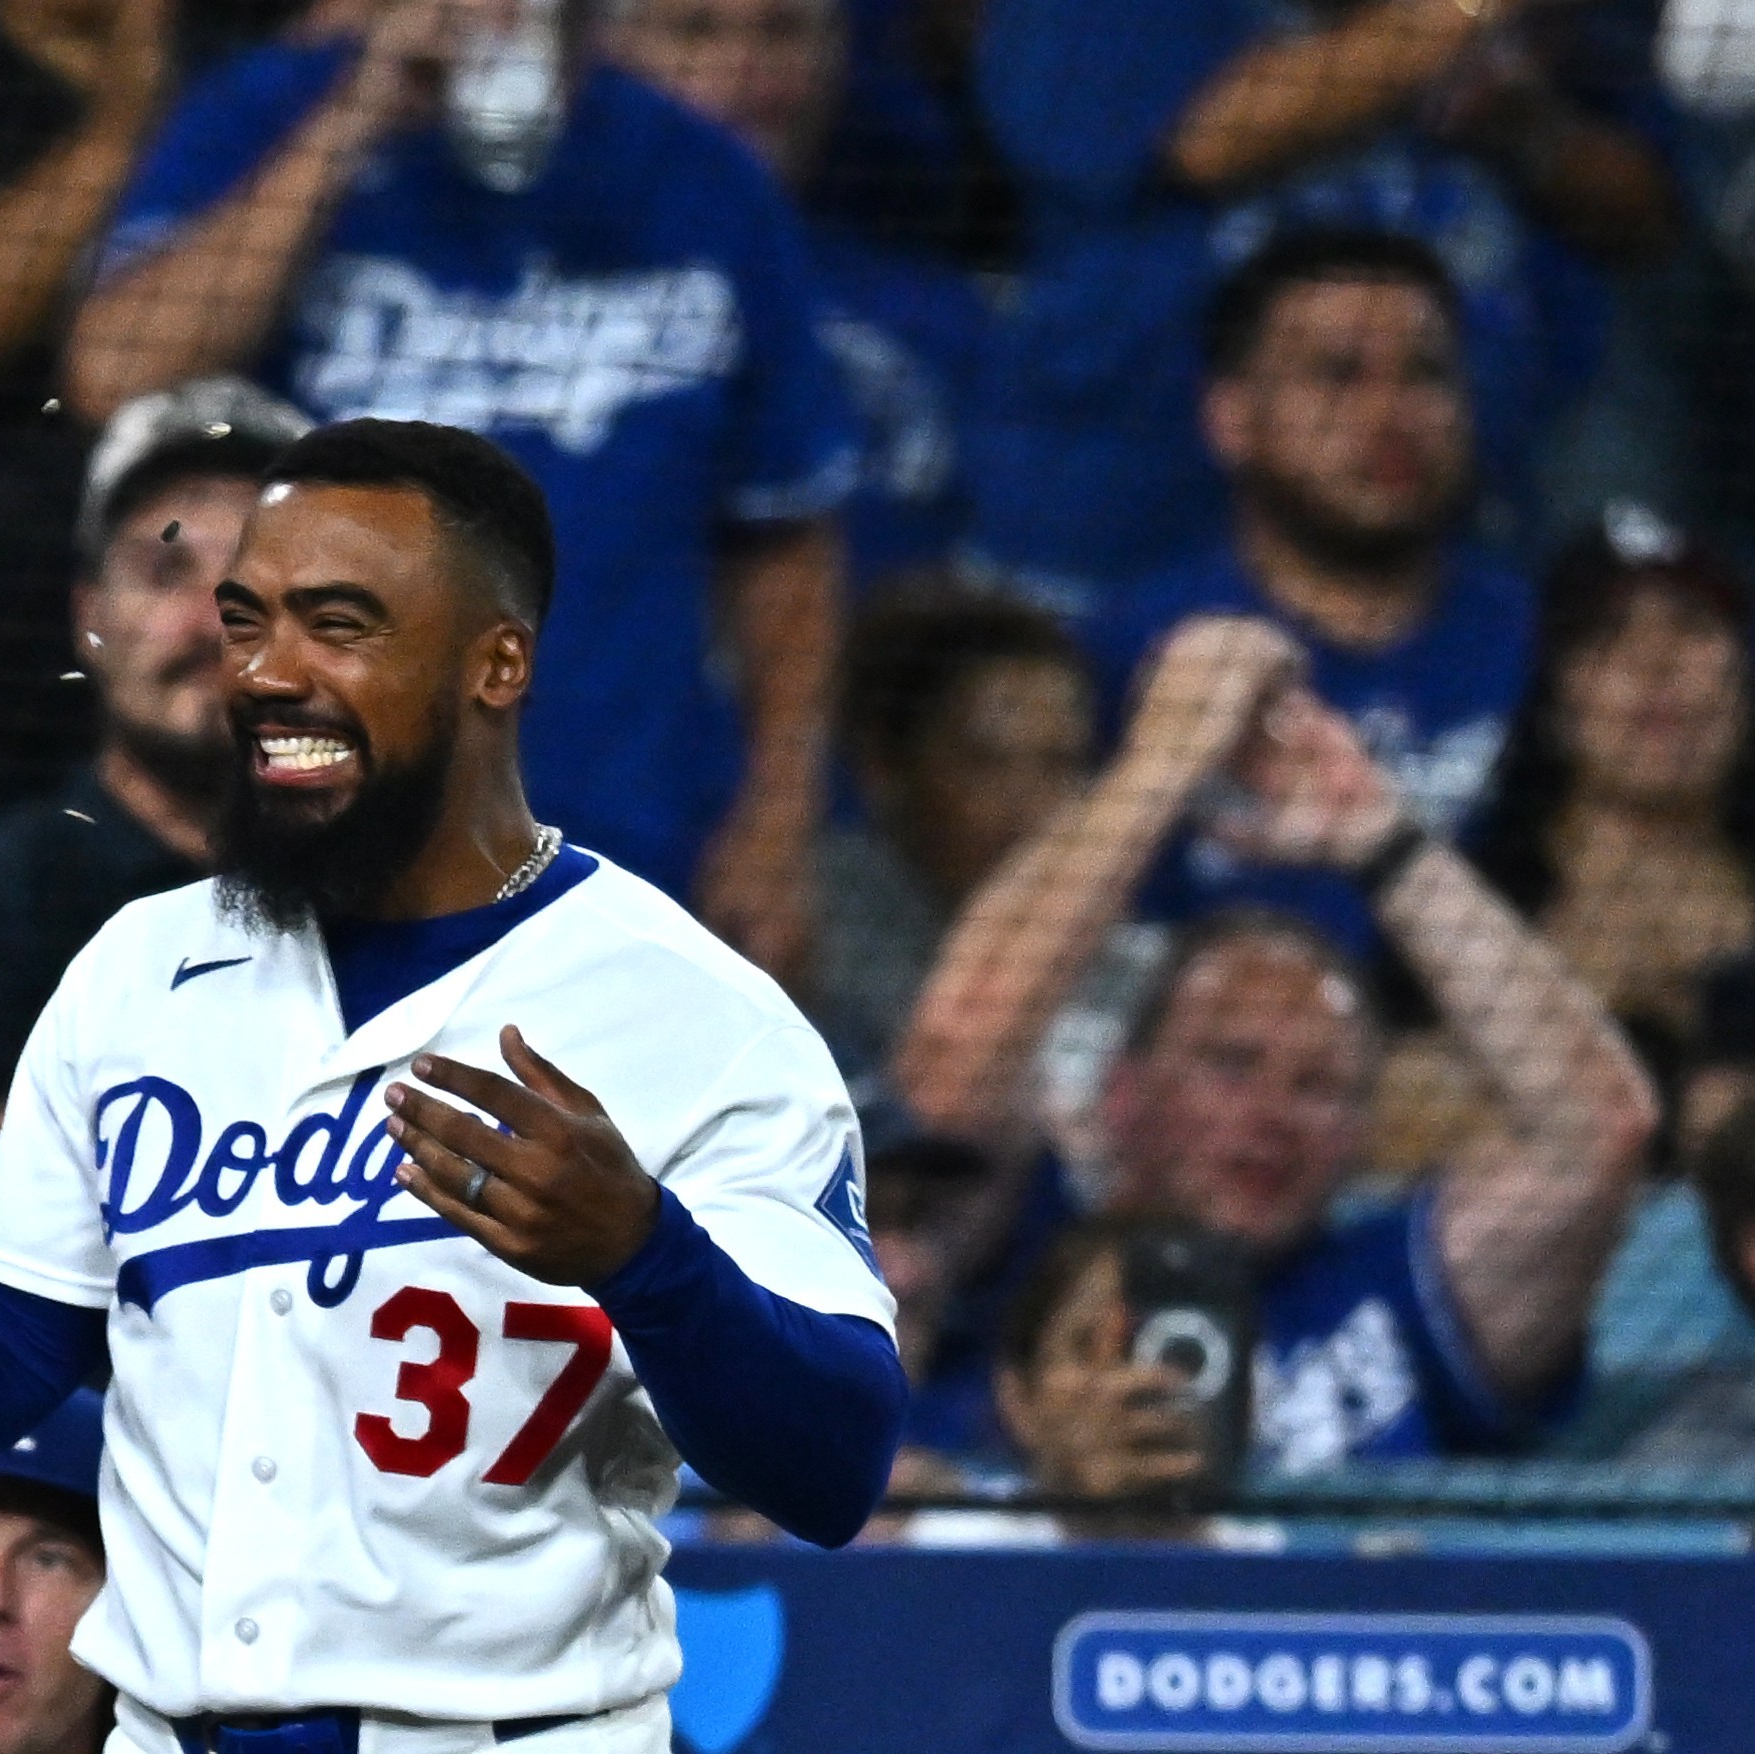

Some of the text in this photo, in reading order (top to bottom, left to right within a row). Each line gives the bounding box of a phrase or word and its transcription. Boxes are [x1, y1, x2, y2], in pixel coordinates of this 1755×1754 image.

[96, 1066, 419, 1309] Dodg
[355, 1286, 613, 1486] 37
[1096, 1652, 1617, 1715] DODGERS.COM
